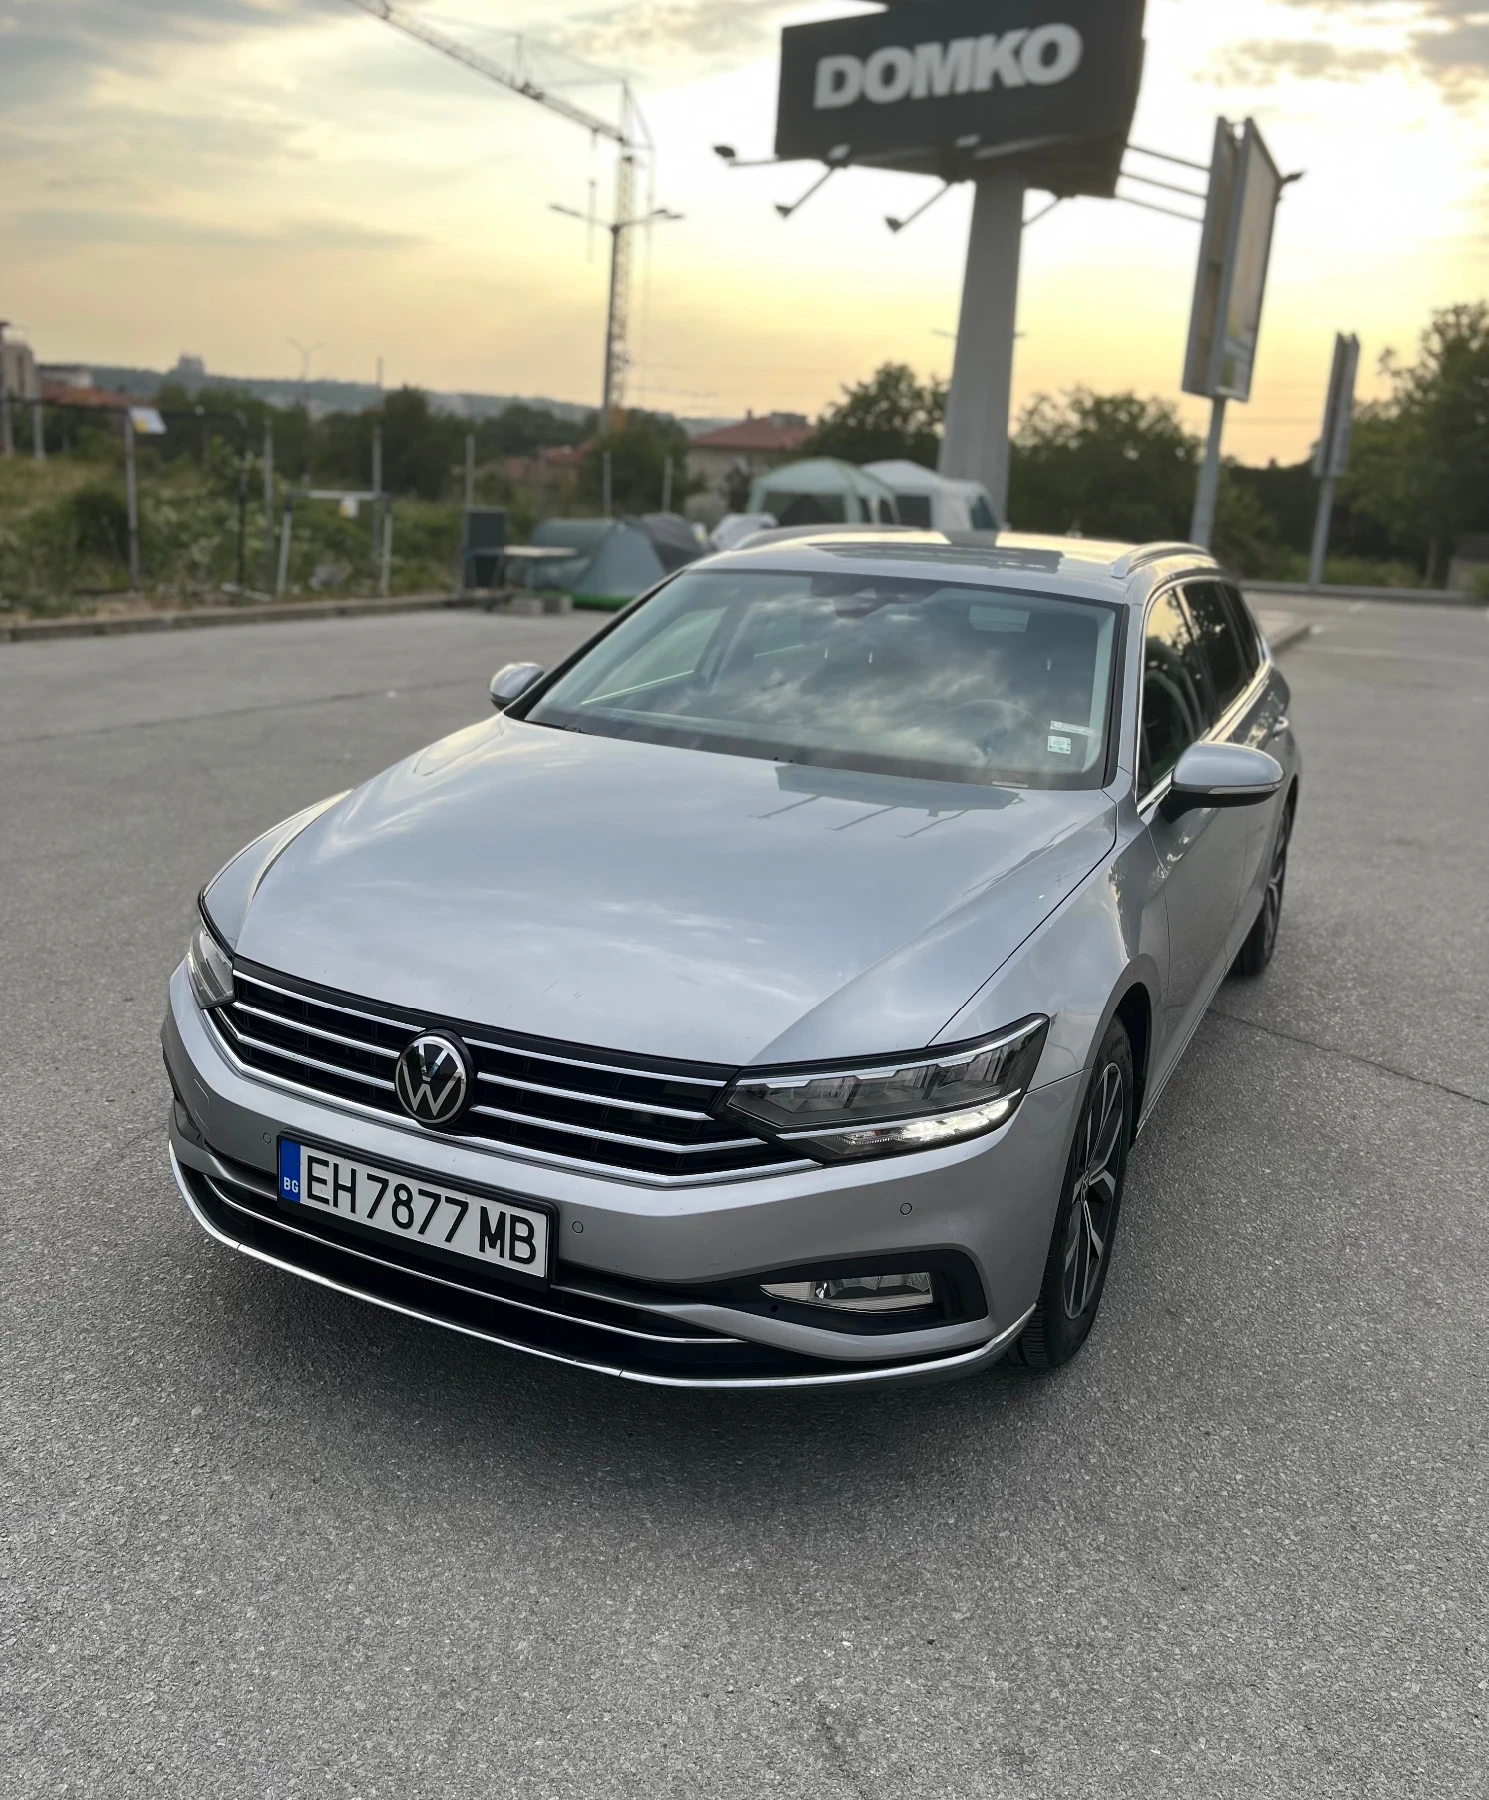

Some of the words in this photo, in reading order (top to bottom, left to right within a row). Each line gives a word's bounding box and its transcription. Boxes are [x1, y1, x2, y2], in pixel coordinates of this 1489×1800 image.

[814, 22, 1084, 109] DOMKO
[396, 1036, 466, 1123] VW
[283, 1177, 299, 1194] BG
[307, 1154, 357, 1214] EH
[366, 1172, 469, 1243] 7877
[479, 1205, 537, 1265] MB
